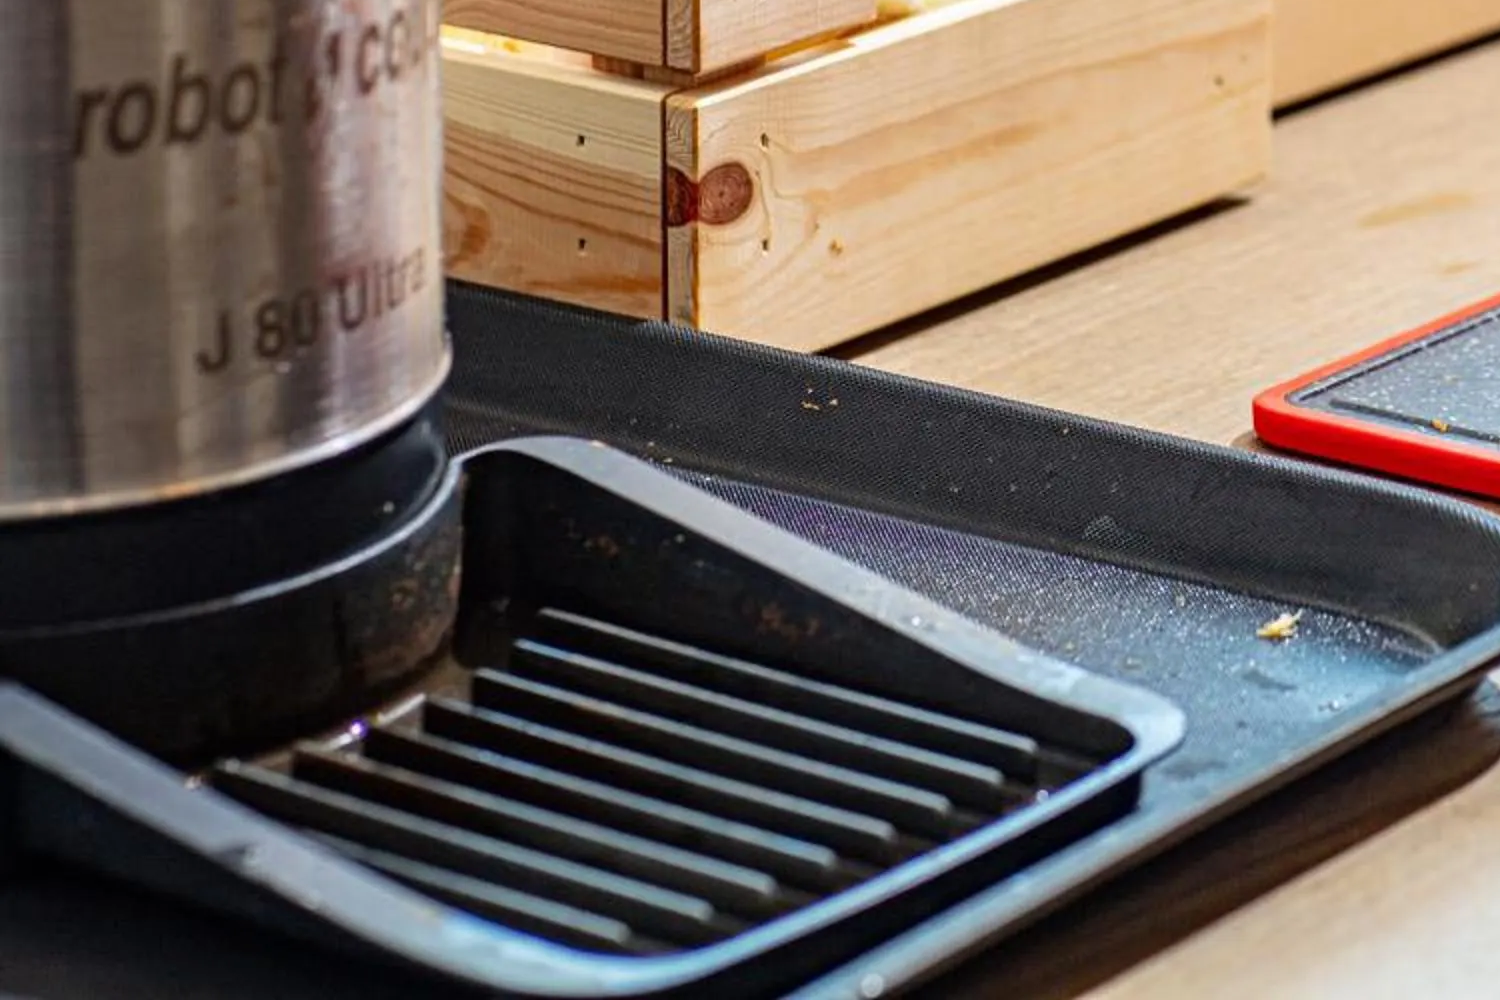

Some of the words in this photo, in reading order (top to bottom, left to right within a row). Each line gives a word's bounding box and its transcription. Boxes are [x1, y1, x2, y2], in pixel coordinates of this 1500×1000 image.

[72, 43, 291, 160] robot
[196, 307, 231, 374] J
[256, 289, 322, 359] 80
[334, 247, 427, 331] Ultra
